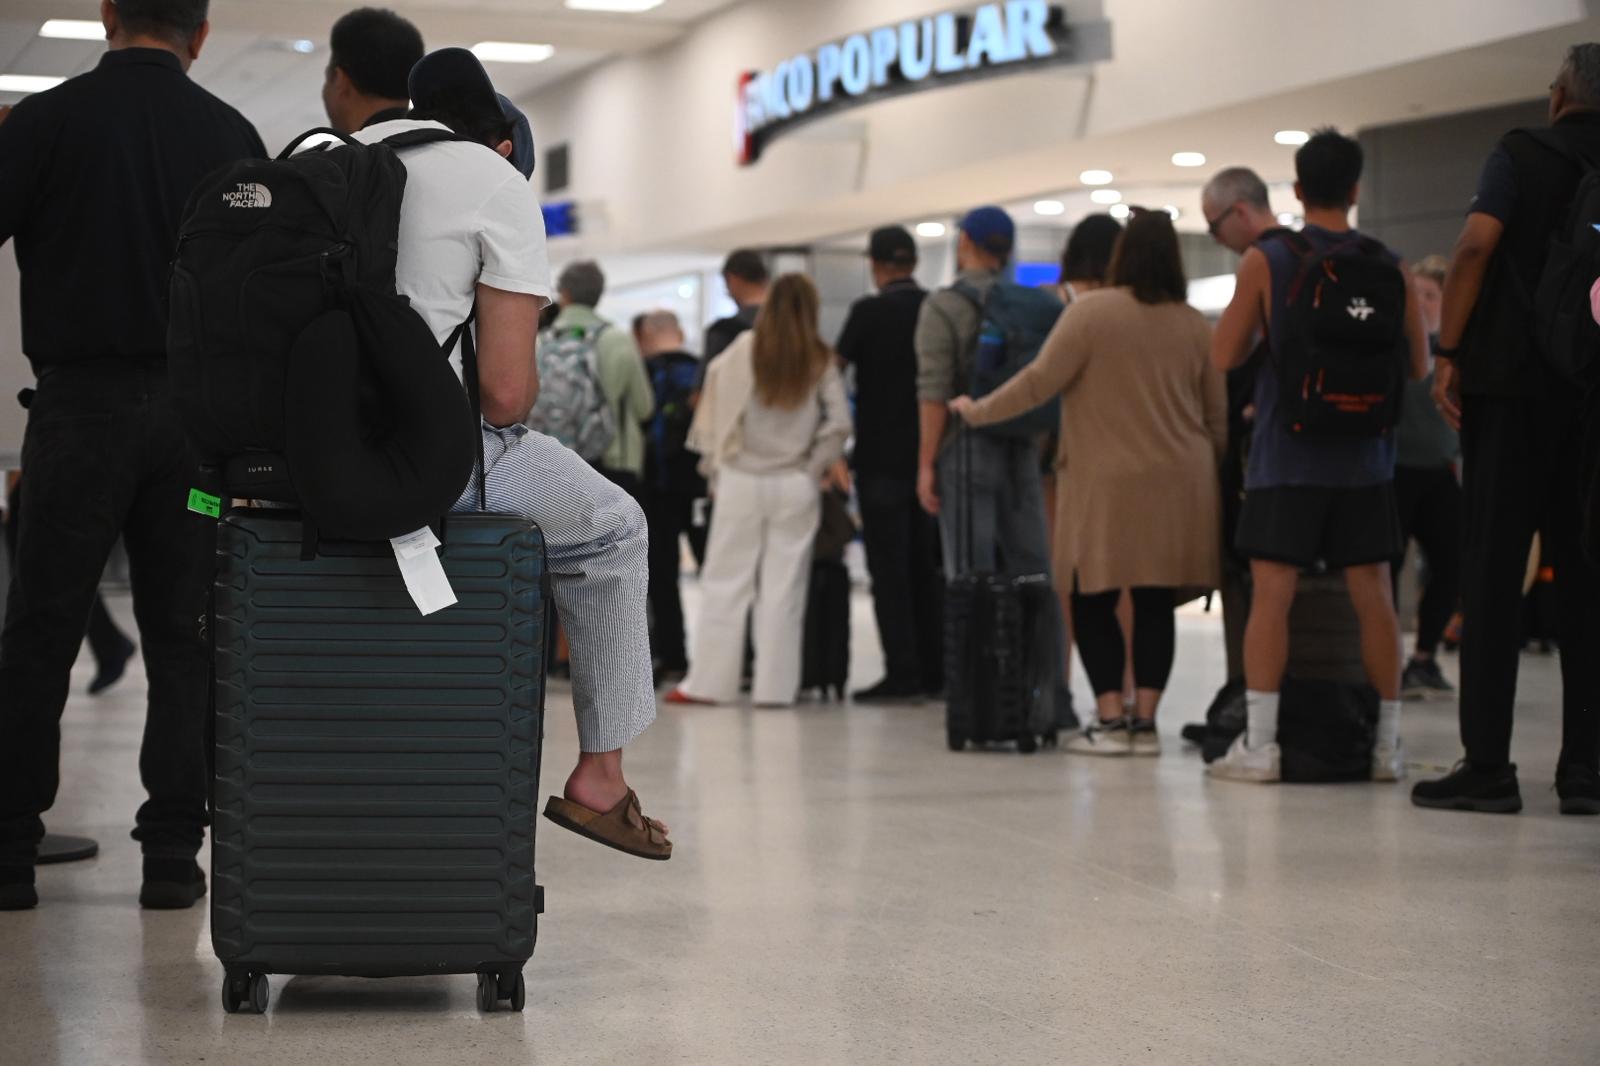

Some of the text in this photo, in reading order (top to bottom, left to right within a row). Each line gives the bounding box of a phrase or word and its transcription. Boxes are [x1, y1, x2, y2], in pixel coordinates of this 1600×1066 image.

[817, 0, 1055, 102] POPULAR
[236, 183, 256, 192] THE
[222, 191, 256, 201] NORTH
[229, 199, 255, 208] FACE
